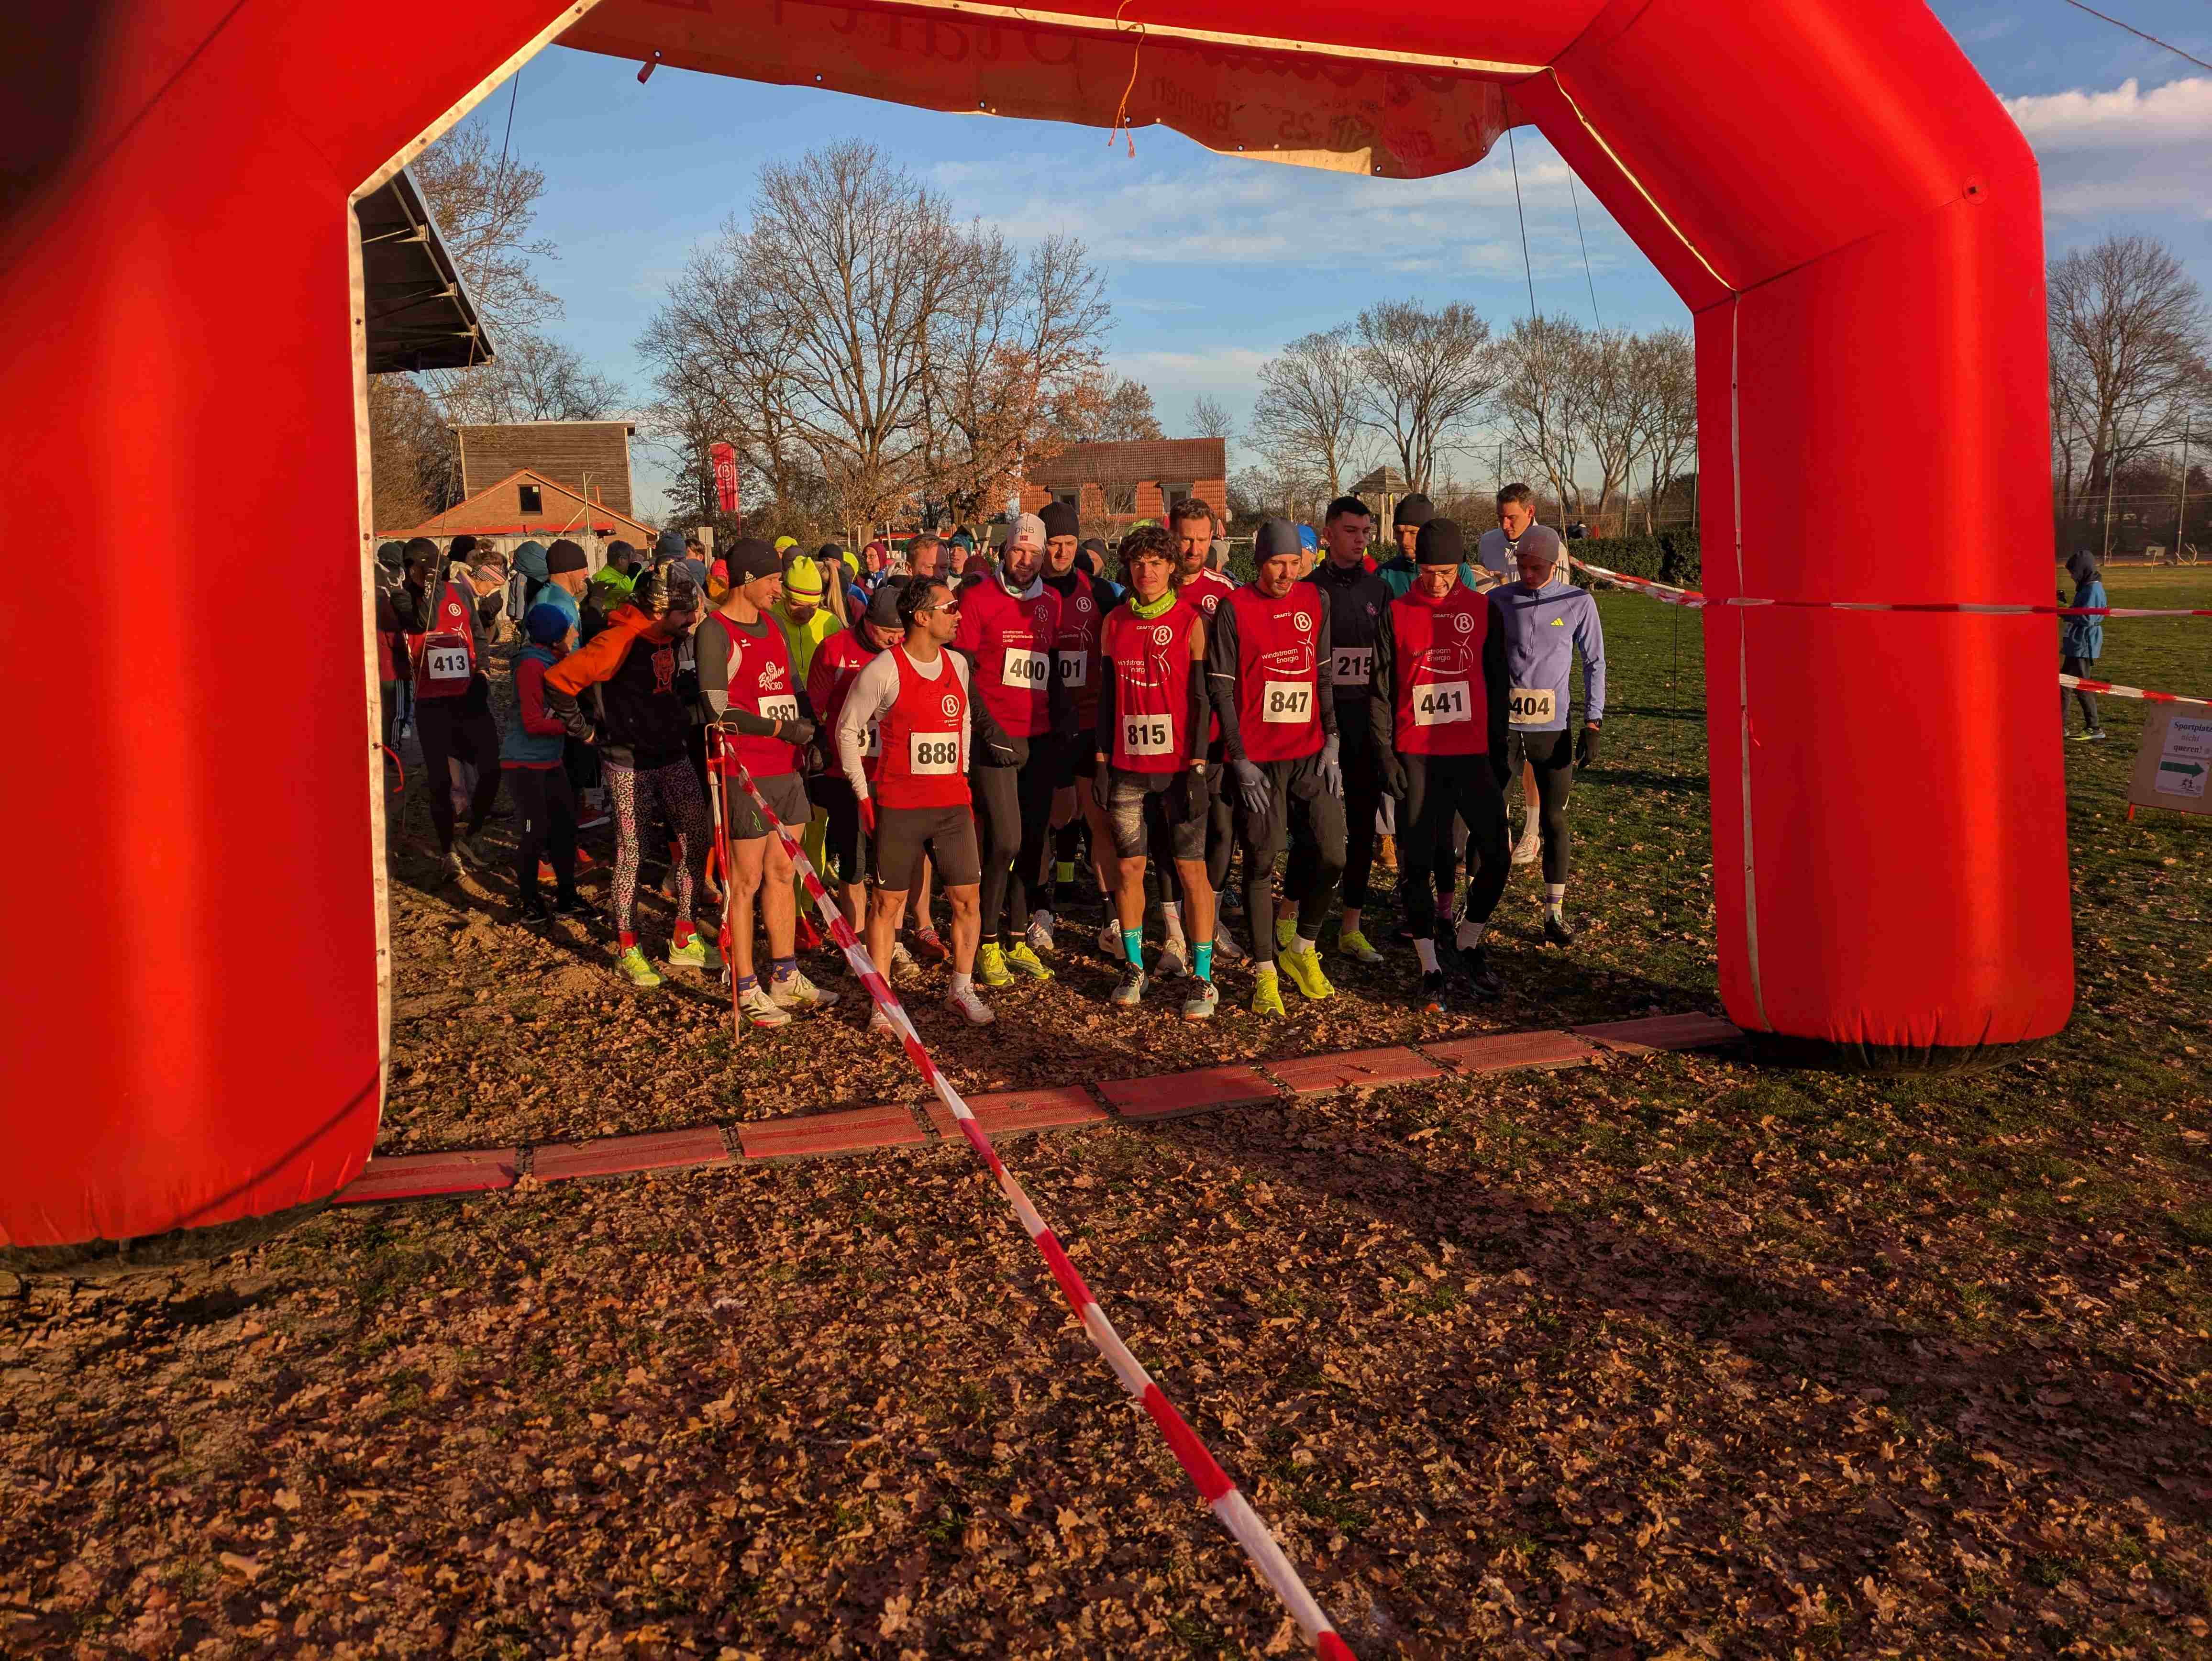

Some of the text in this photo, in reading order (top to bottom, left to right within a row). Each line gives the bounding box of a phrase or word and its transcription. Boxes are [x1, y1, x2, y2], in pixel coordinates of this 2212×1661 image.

[1014, 526, 1034, 535] DNB
[1261, 648, 1298, 660] windstream
[1276, 655, 1299, 664] Energie
[1412, 648, 1451, 657] windstream
[433, 654, 466, 672] 413
[1010, 658, 1045, 681] 400
[1060, 660, 1081, 678] 01
[1338, 656, 1371, 676] 215
[765, 681, 783, 691] NORD
[1270, 691, 1308, 713] 847
[1420, 690, 1462, 715] 441
[1509, 696, 1550, 716] 404
[766, 704, 796, 720] 887
[1128, 724, 1166, 745] 815
[918, 742, 957, 764] 888
[2173, 744, 2202, 753] queren!
